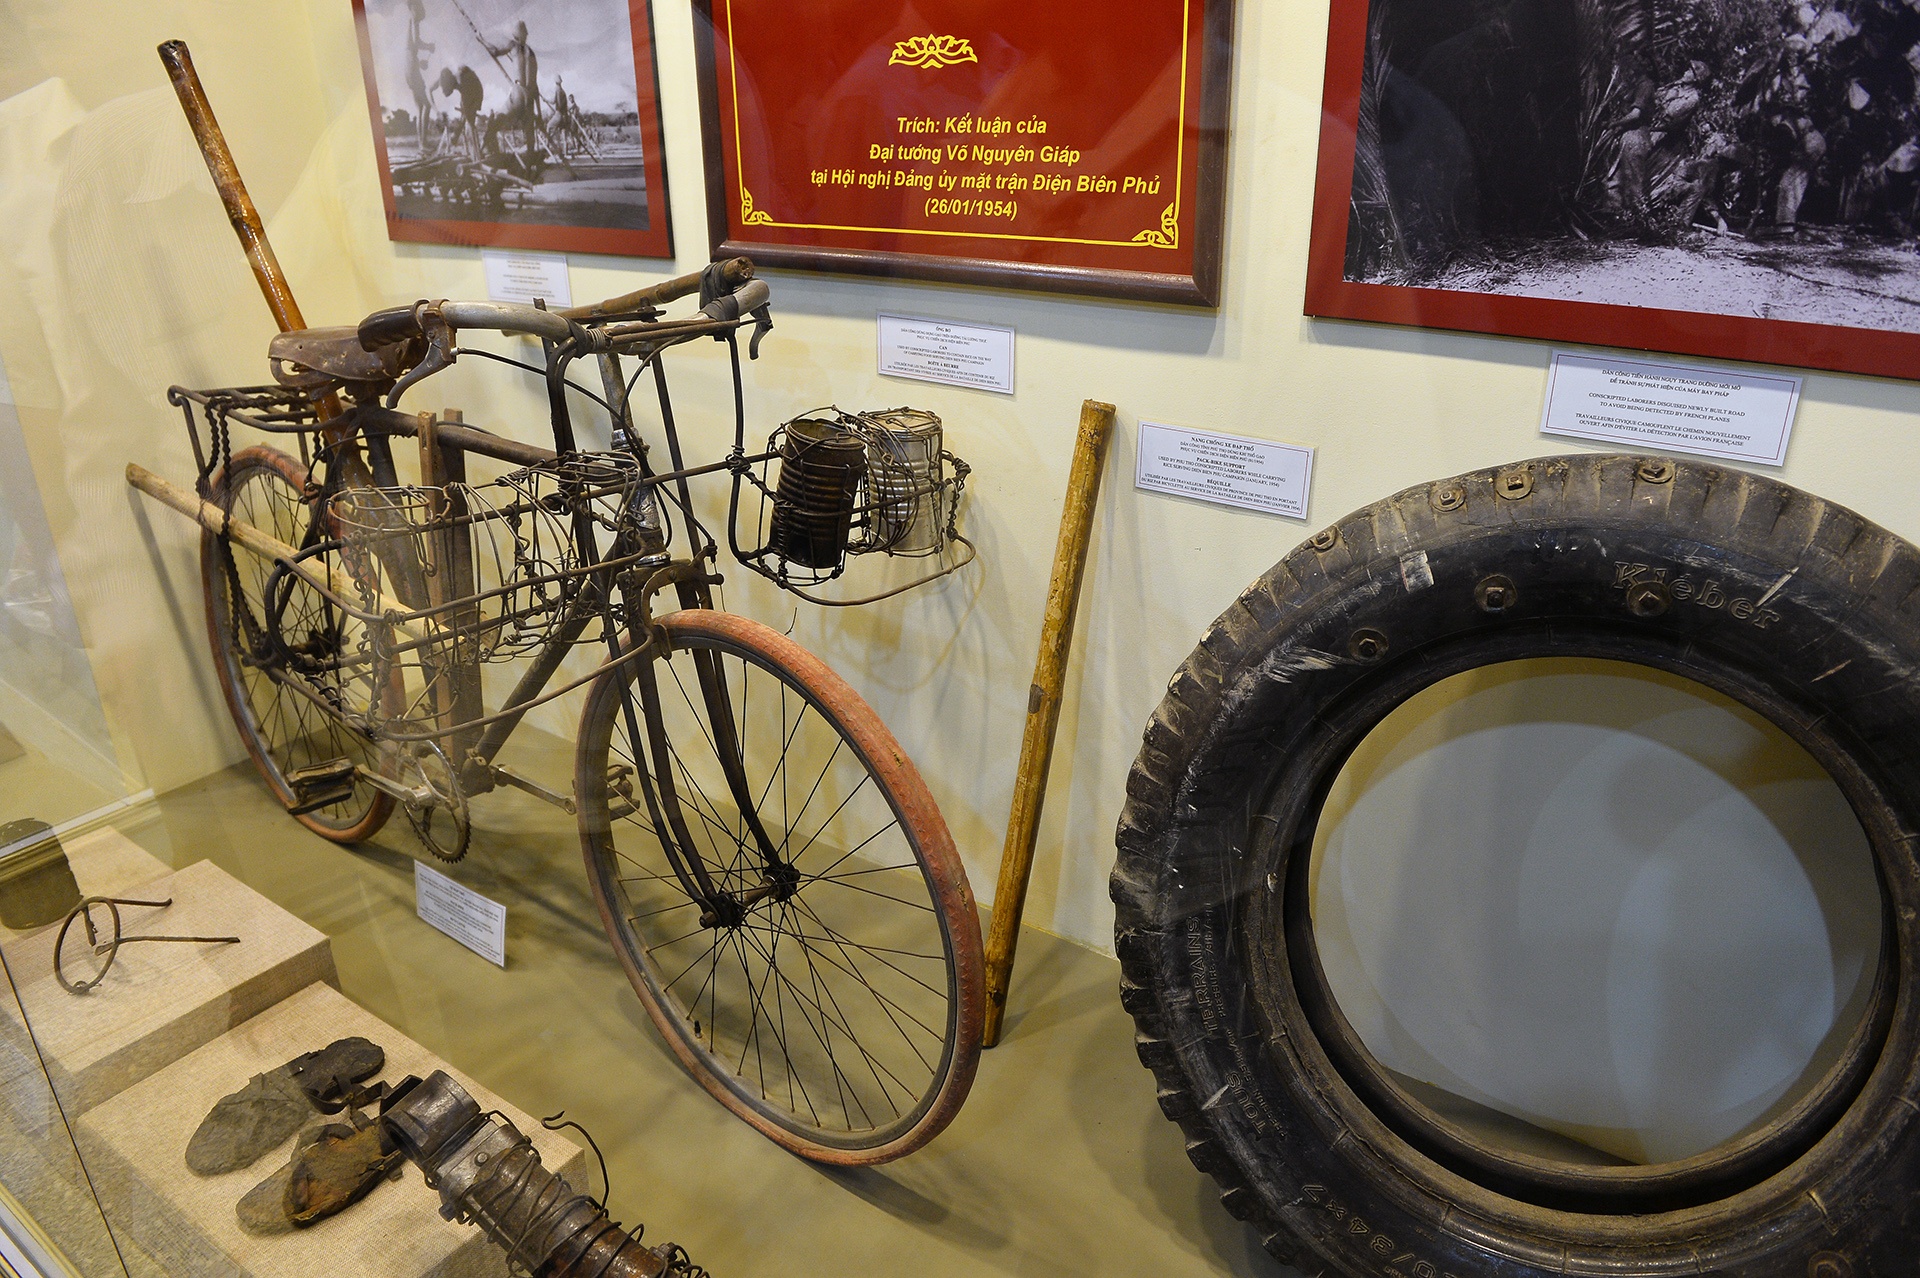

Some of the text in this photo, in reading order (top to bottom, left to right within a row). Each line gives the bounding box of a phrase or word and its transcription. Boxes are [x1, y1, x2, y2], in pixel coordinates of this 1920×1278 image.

[898, 113, 1046, 137] Trích: Kết luận của
[870, 144, 1080, 166] Đại tướng Võ Nguyên Giáp
[812, 169, 1160, 195] tại Hội nghị Đảng ủy mặt trận Điện Biên Phủ
[925, 198, 1017, 220] (26/01/1954)
[1589, 392, 1626, 402] CONSCRIPTED
[1627, 397, 1656, 405] LABORERS
[1657, 401, 1687, 409] DISGUISED
[1645, 407, 1674, 416] DETECTED
[1684, 412, 1707, 420] FRENCH
[1708, 415, 1730, 423] PLANES
[1186, 916, 1266, 1135] TOUS TERRAINS
